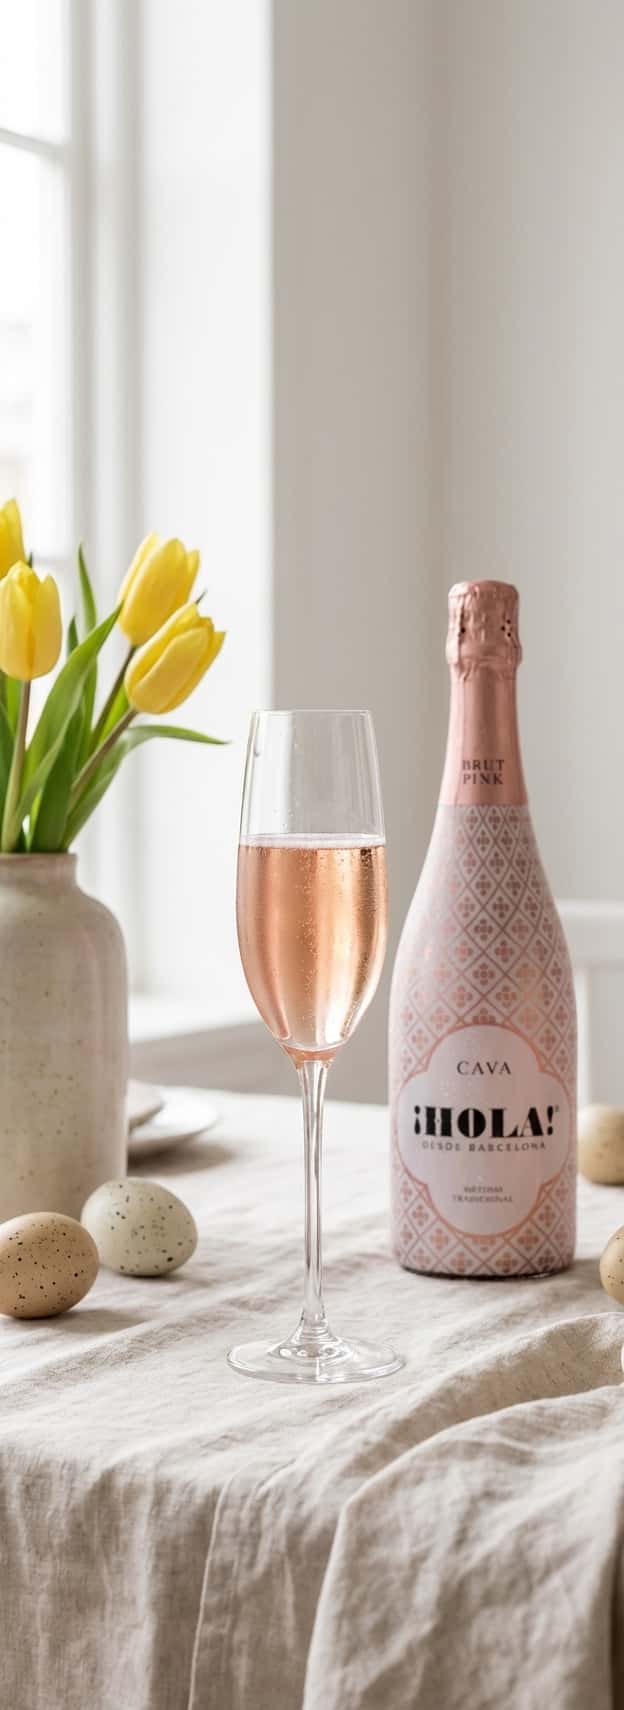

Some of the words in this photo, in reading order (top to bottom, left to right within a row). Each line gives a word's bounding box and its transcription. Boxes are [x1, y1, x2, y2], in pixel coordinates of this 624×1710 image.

[462, 773, 504, 785] PINK
[456, 1060, 512, 1076] CAVA
[422, 1141, 461, 1151] DESDE
[468, 1141, 547, 1152] BARCELONA
